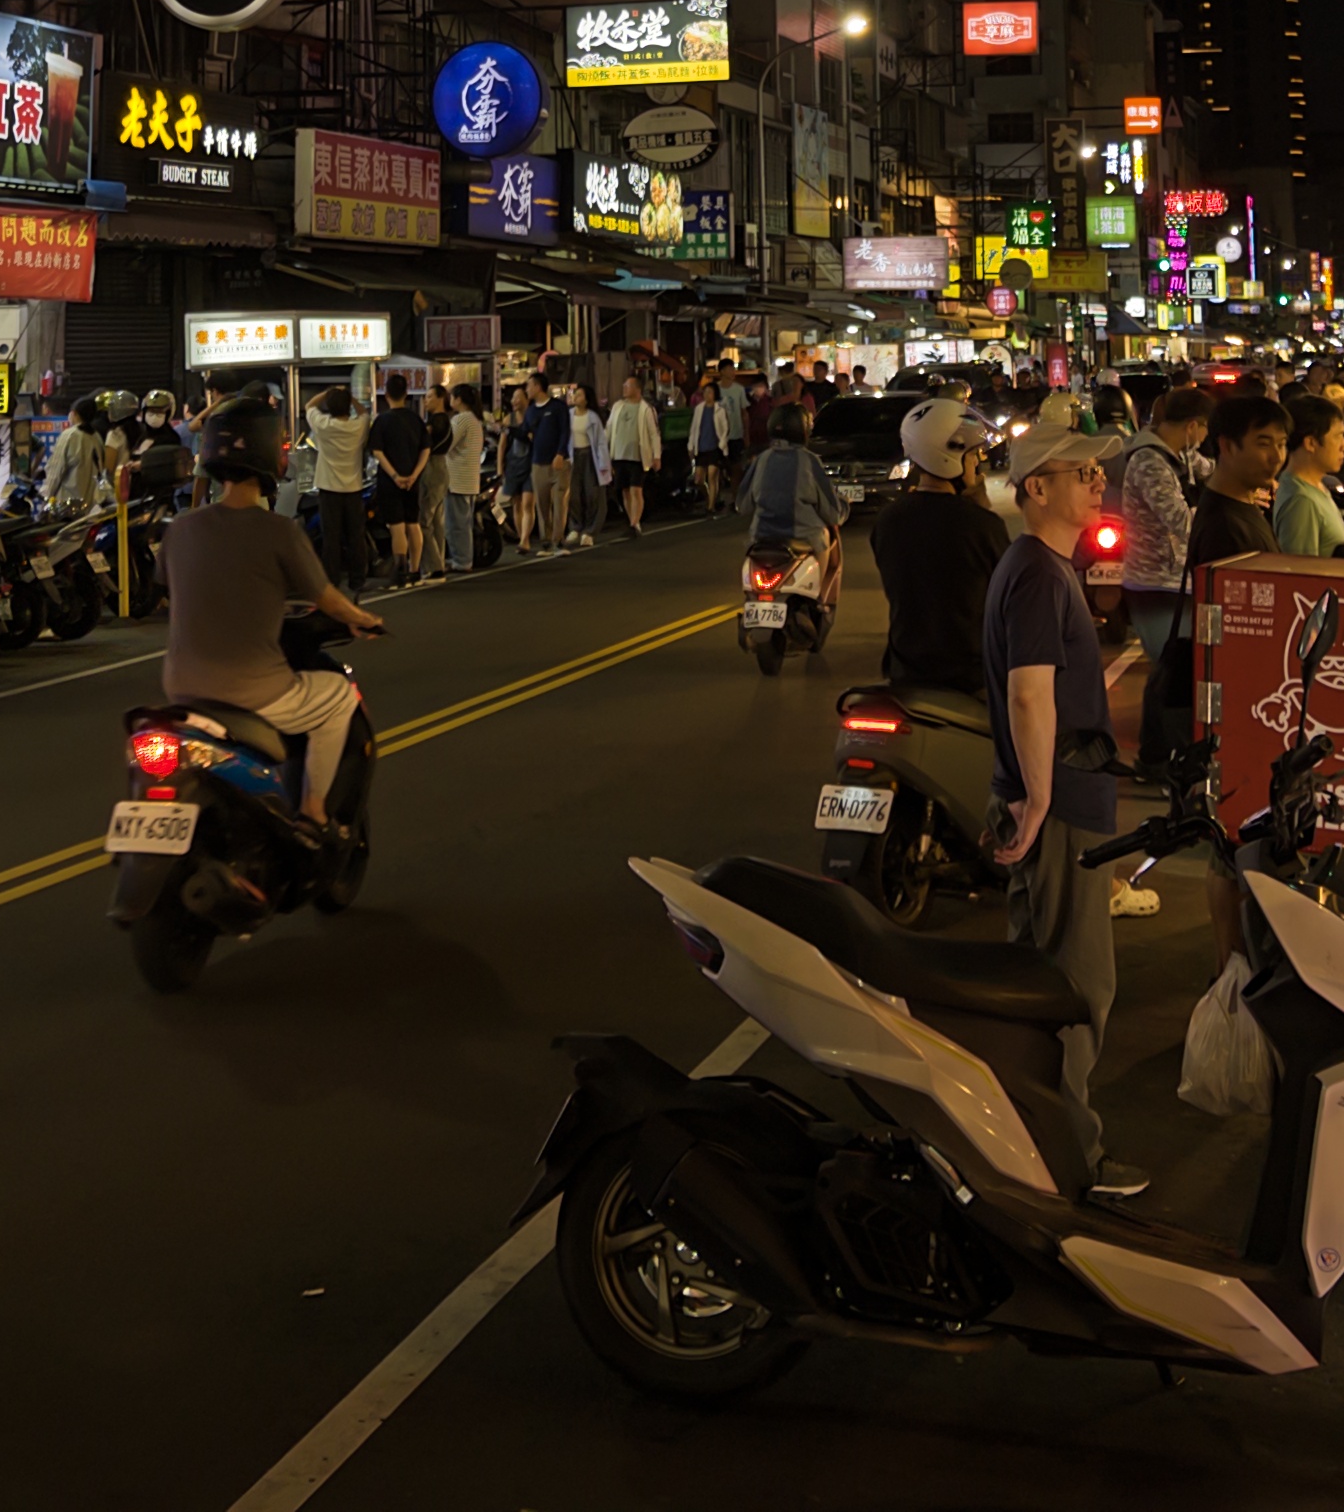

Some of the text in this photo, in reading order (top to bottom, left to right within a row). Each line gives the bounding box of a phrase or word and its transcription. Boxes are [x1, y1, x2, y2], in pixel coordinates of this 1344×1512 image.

[119, 86, 203, 154] 老夫子
[162, 164, 230, 188] BUDGET STEAK
[819, 796, 889, 822] ERN-0776
